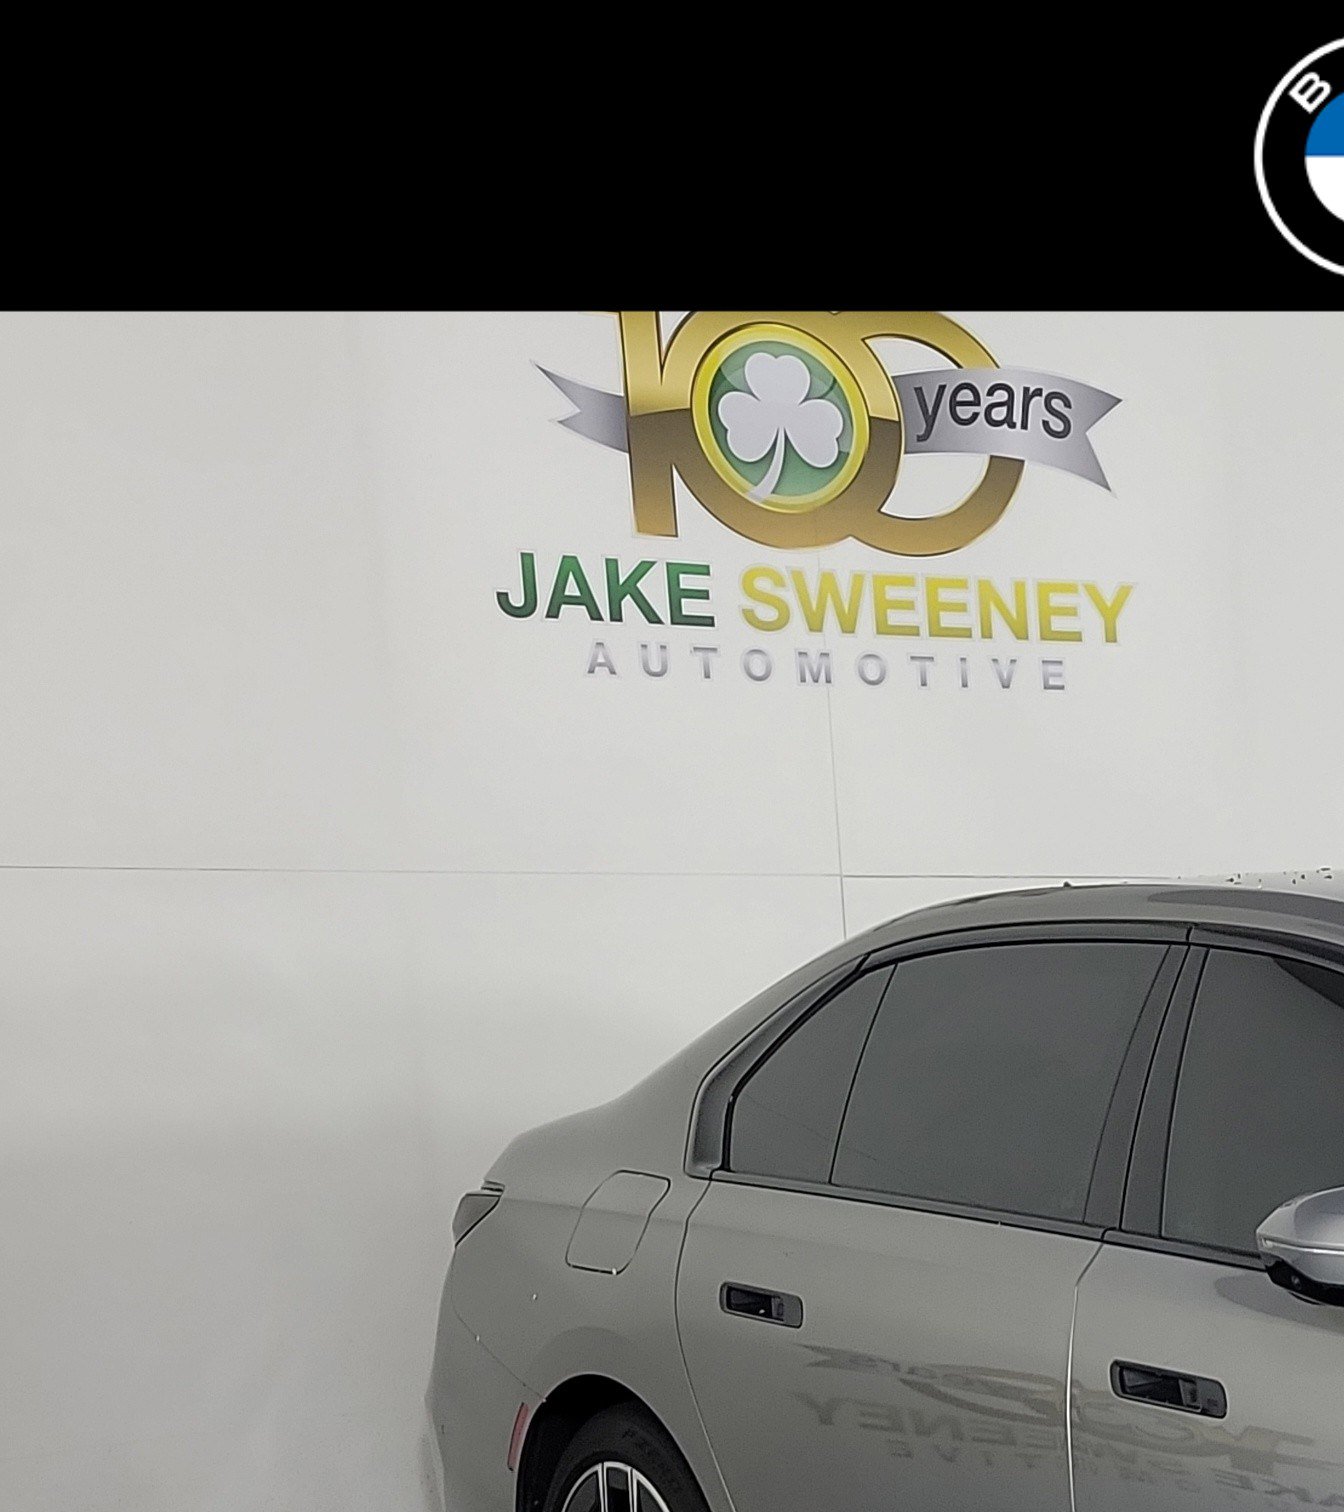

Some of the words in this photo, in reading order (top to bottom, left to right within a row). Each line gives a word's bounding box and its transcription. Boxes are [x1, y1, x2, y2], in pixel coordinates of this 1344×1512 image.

[913, 380, 1073, 443] years
[495, 551, 716, 628] JAKE
[740, 566, 1135, 644] SWEENEY
[586, 641, 1066, 691] AUTOMOTIVE
